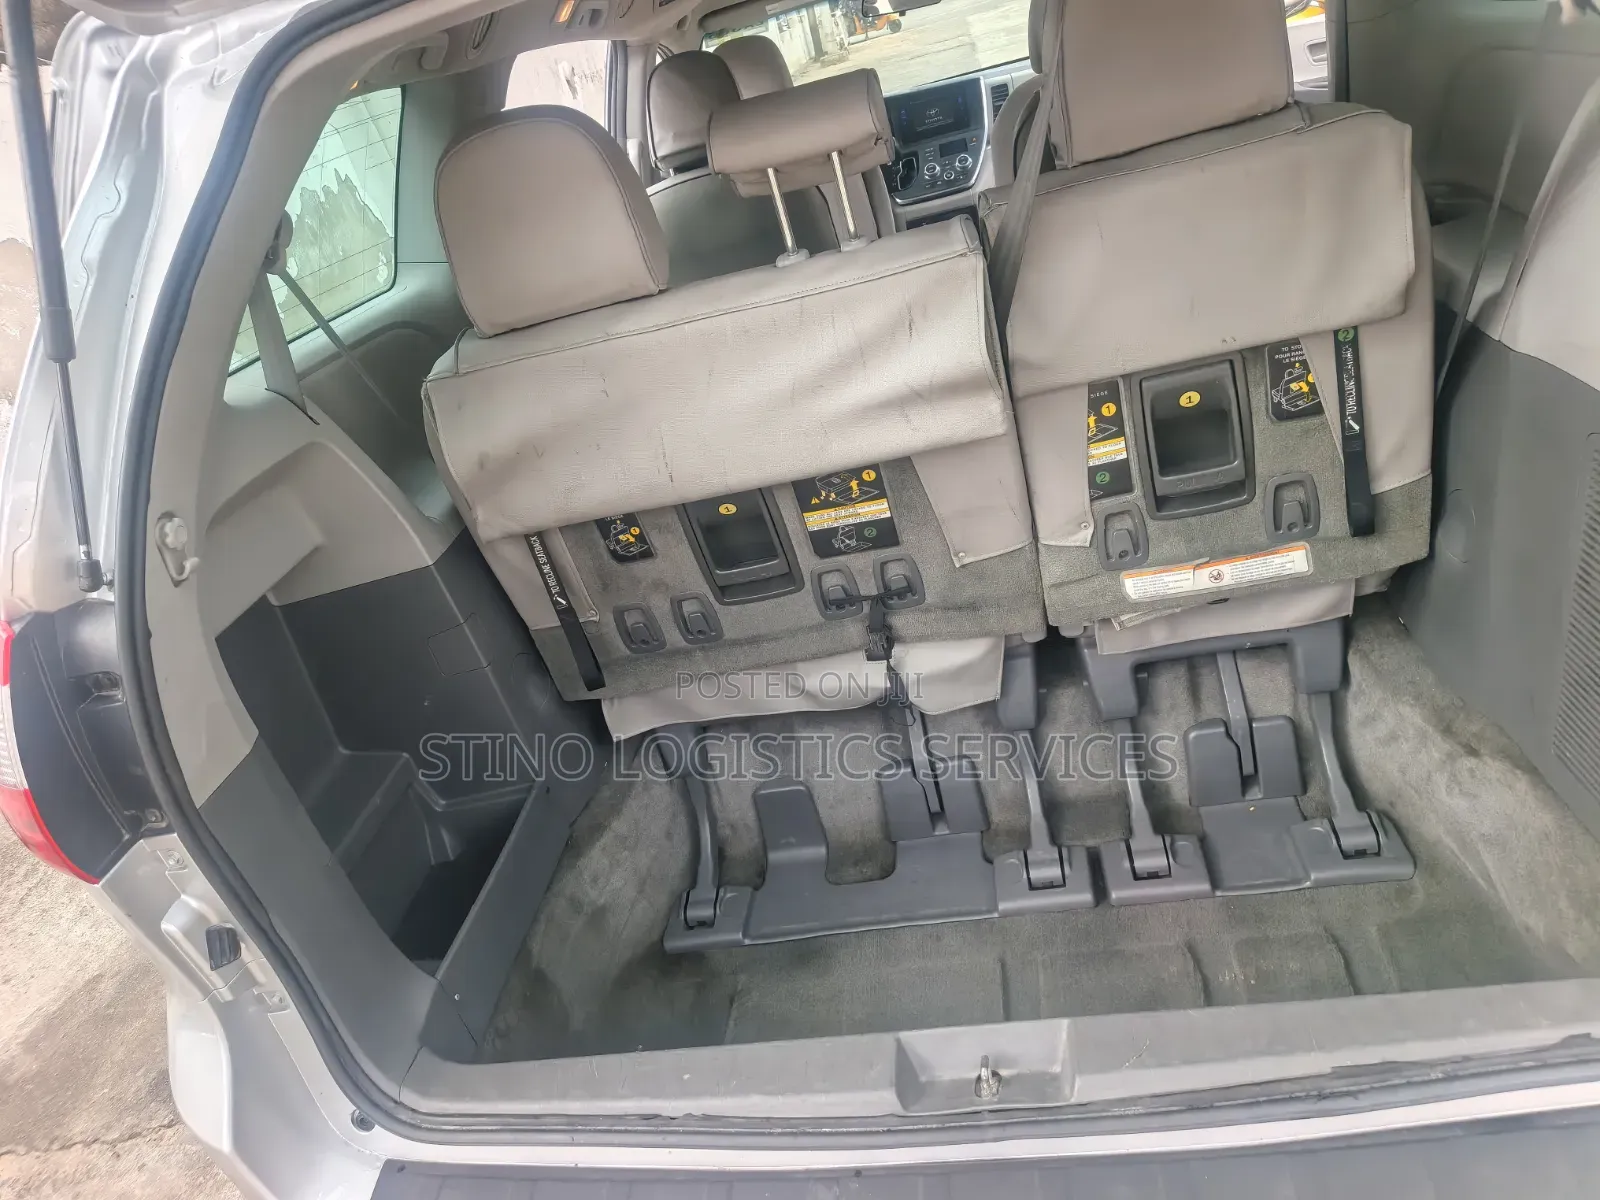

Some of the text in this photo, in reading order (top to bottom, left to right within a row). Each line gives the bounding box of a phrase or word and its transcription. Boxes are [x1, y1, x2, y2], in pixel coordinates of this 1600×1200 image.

[1274, 352, 1291, 360] POUR
[529, 534, 560, 593] TO RECLINE SEATBACK
